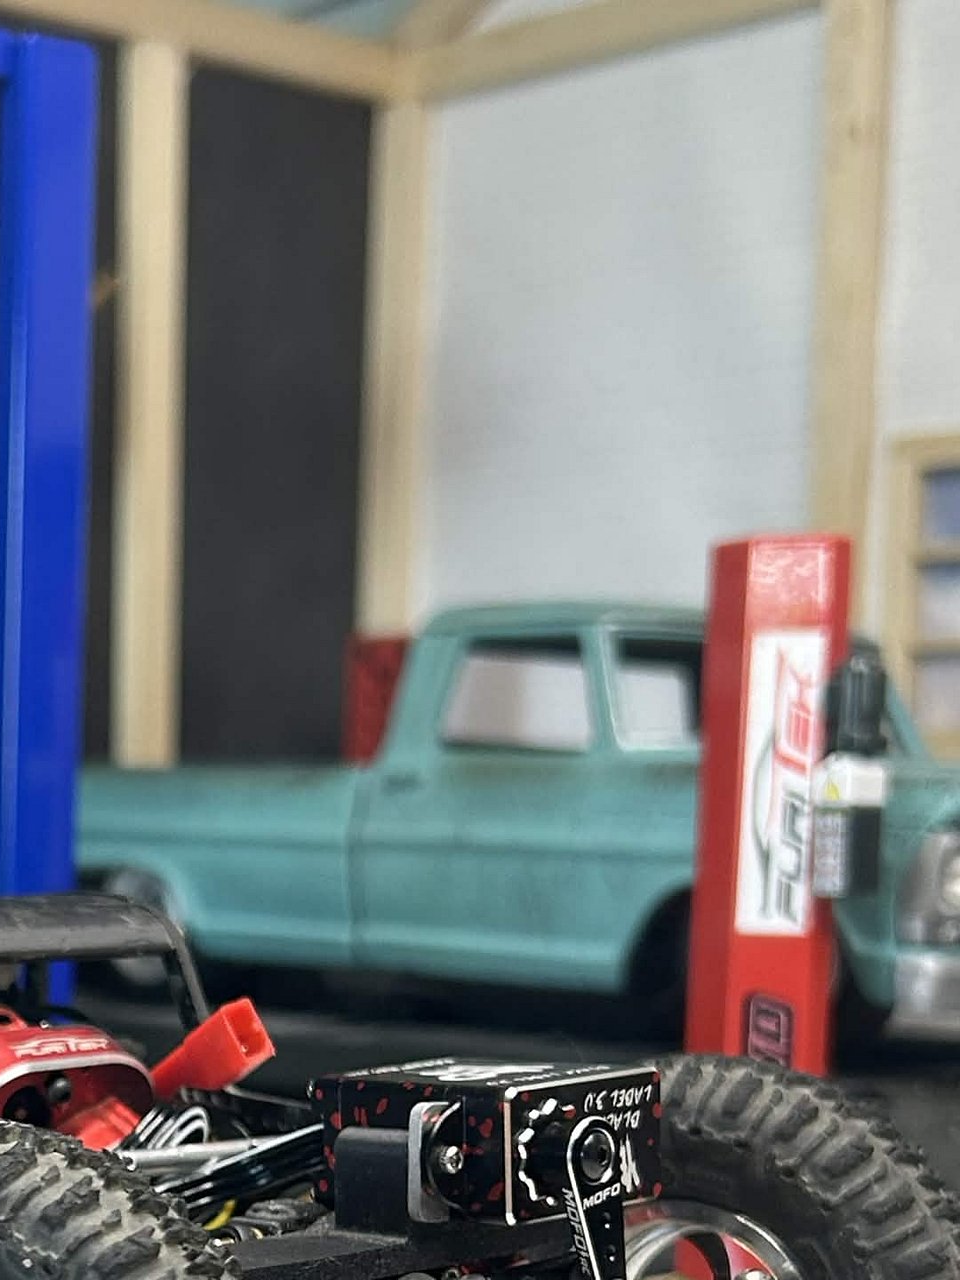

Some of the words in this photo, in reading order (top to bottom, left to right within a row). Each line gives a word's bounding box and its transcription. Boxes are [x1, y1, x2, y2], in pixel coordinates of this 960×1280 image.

[583, 1090, 607, 1113] 3.0
[610, 1084, 653, 1109] LABEL
[602, 1109, 640, 1131] BLAC
[583, 1182, 621, 1210] MOFO
